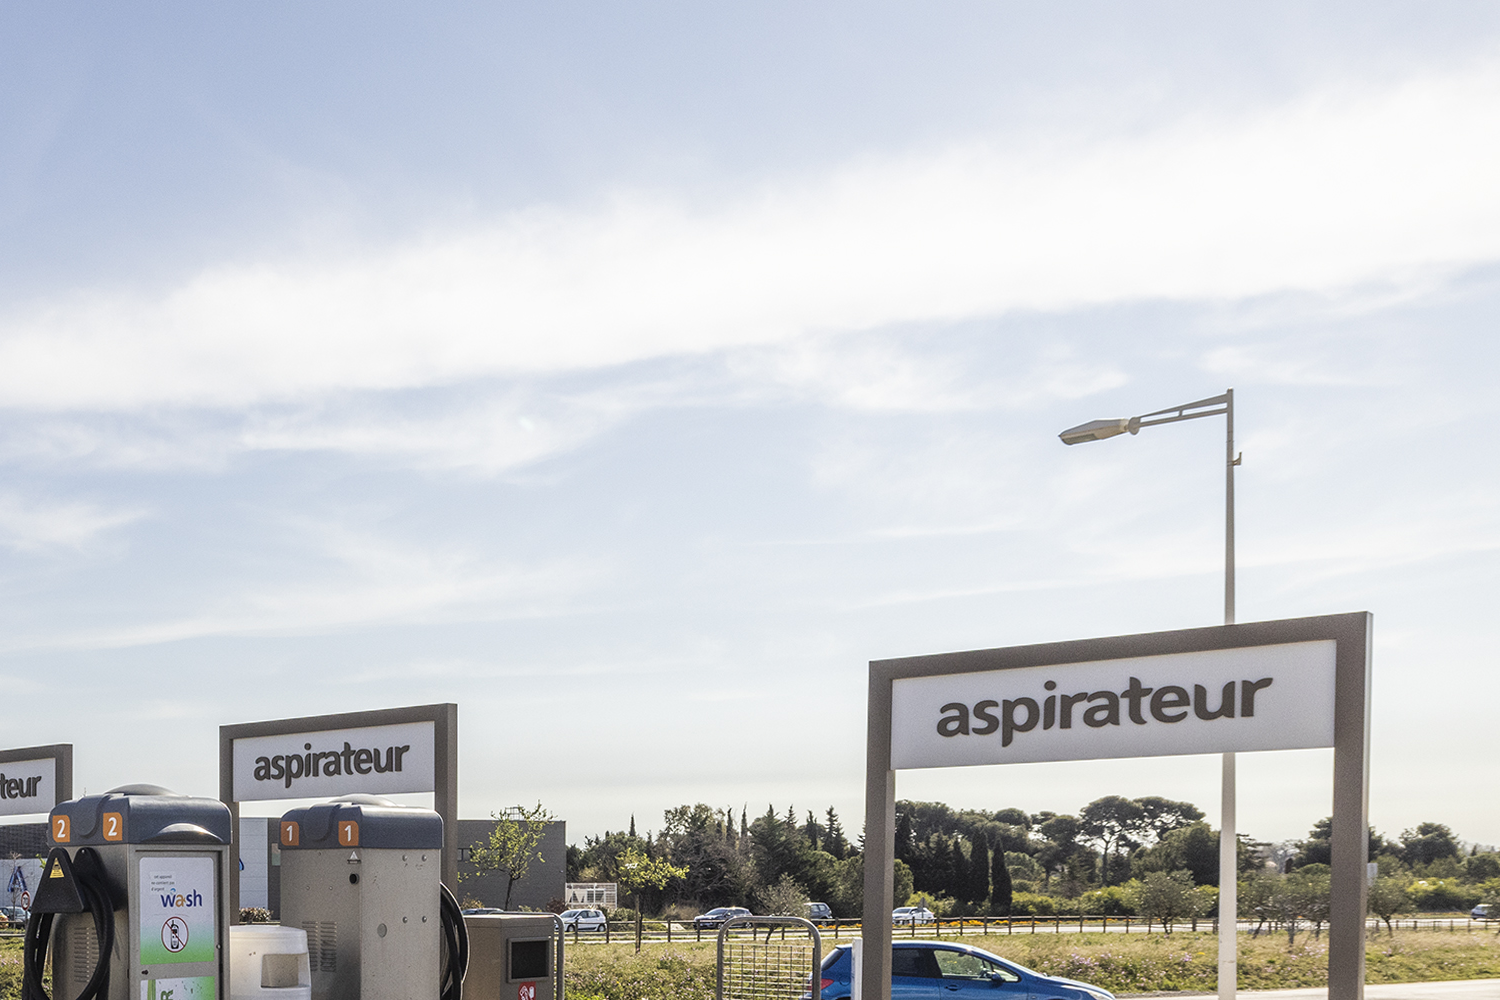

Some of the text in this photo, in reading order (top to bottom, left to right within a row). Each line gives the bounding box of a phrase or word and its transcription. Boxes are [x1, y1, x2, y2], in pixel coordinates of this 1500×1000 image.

[936, 676, 1274, 748] aspirateur
[253, 741, 411, 789] aspirateur
[56, 819, 66, 839] 2
[107, 816, 118, 837] 2
[286, 825, 293, 842] 1
[344, 824, 352, 842] 1
[160, 888, 203, 908] wash
